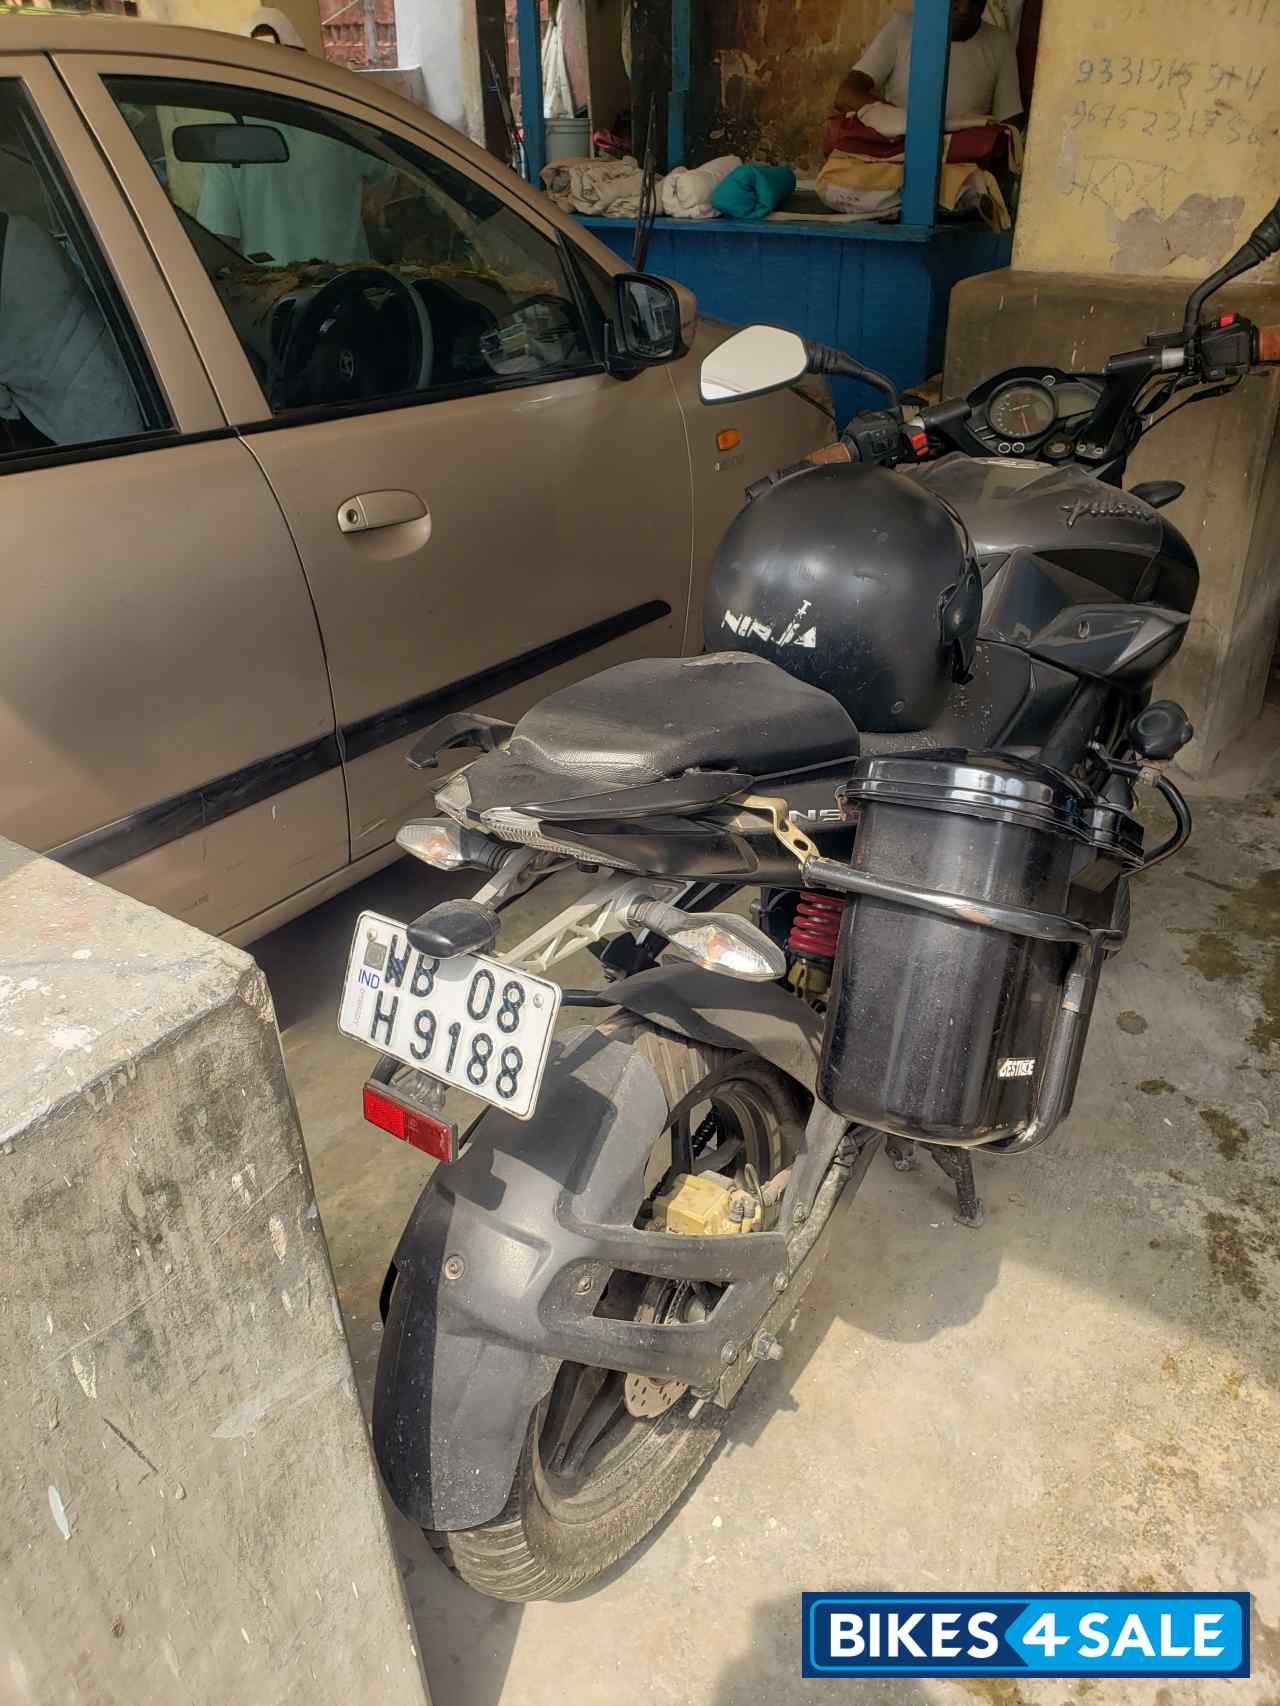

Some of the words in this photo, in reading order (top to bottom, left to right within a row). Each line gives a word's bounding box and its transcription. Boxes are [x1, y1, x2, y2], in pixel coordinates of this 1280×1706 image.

[358, 968, 380, 989] IND
[384, 934, 440, 997] WB
[467, 968, 526, 1033] 08
[371, 990, 399, 1046] H
[410, 1009, 524, 1099] 9188
